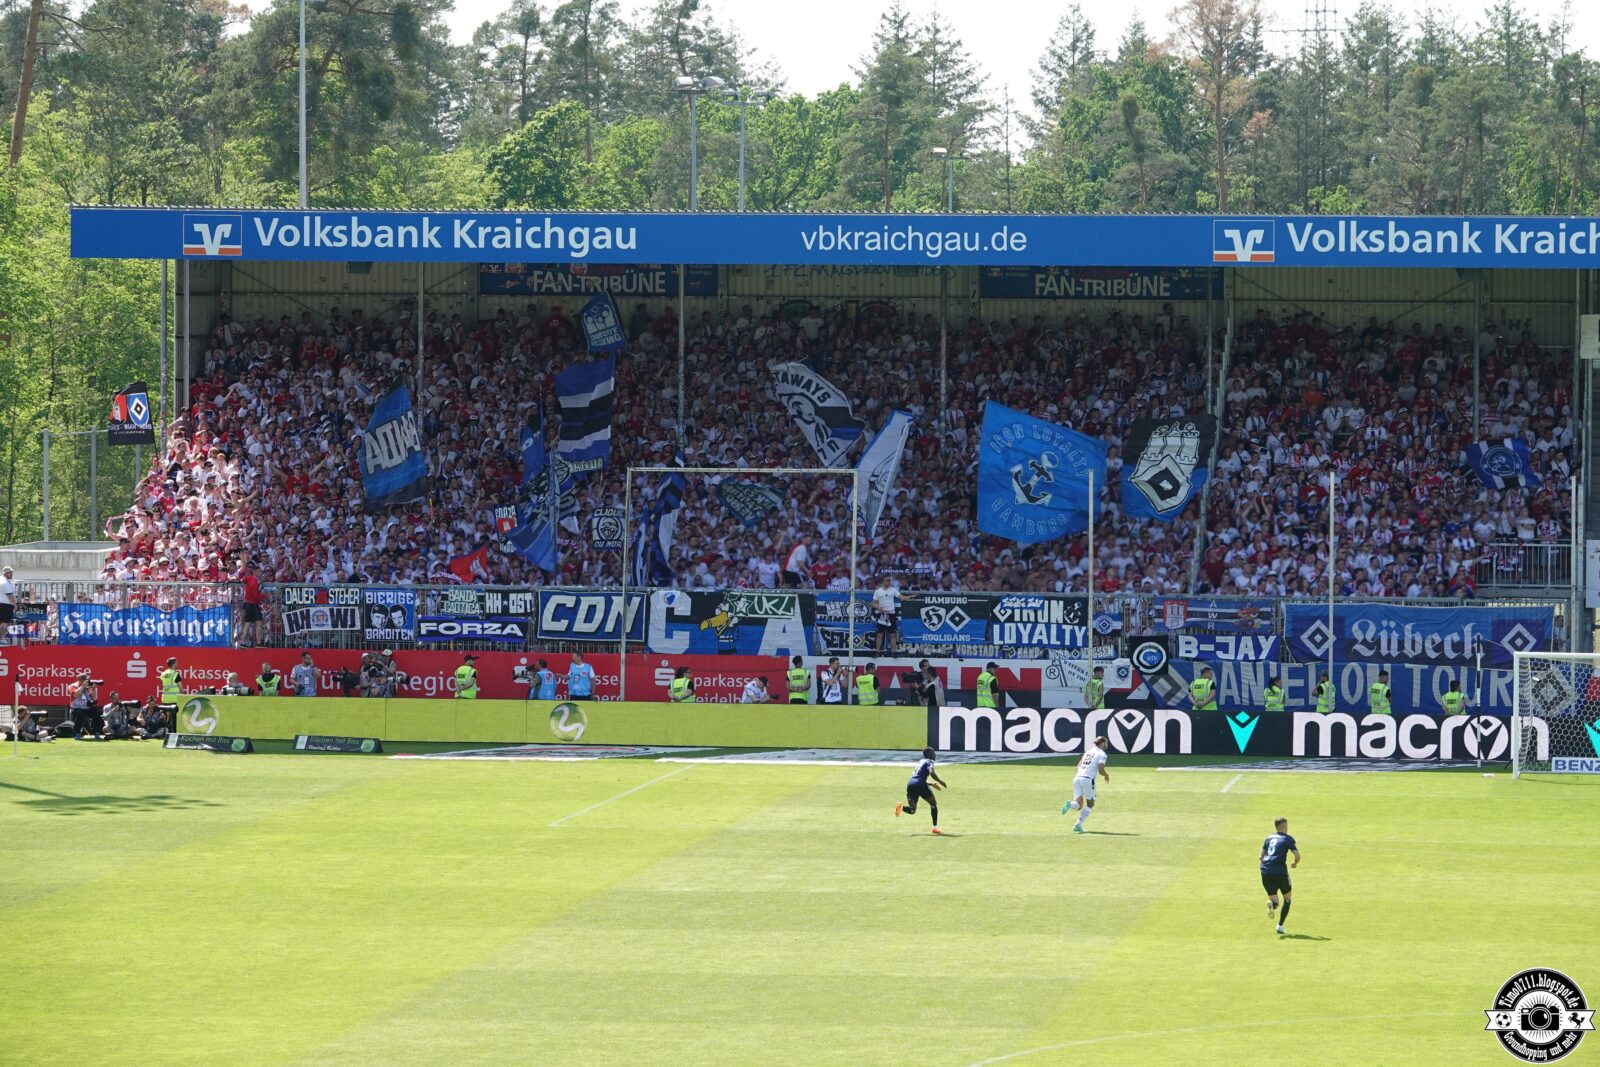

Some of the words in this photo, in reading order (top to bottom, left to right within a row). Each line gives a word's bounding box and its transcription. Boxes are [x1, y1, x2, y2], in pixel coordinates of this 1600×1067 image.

[254, 216, 442, 248] Volksbank
[453, 217, 637, 258] Kraichgau
[801, 224, 1028, 258] vbkraichgau.de
[1287, 220, 1482, 254] Volksbank
[533, 269, 666, 294] FAN-TRIBÜNE
[1035, 271, 1171, 296] FAN-TRIBÜNE
[594, 508, 624, 517] CLIQUE
[285, 588, 315, 604] DAUER
[328, 588, 360, 604] STEHER
[365, 591, 414, 604] BIERIGE
[924, 596, 968, 604] HAMBURG
[542, 594, 641, 633] CDN
[61, 611, 230, 643] Hafensänger
[365, 628, 414, 640] BANDITEN
[420, 622, 524, 637] FORZA
[922, 633, 971, 641] HOOLIGANS
[993, 622, 1088, 647] LOYALTY
[1352, 618, 1485, 660] Lübeck
[956, 644, 1000, 657] VORSTADT
[1178, 635, 1277, 660] B-JAY
[17, 663, 92, 680] Sparkasse
[156, 665, 231, 680] Sarkasse
[394, 671, 481, 696] Regio.
[693, 673, 759, 690] parkase
[938, 706, 1193, 755] macron
[1292, 711, 1550, 761] macron
